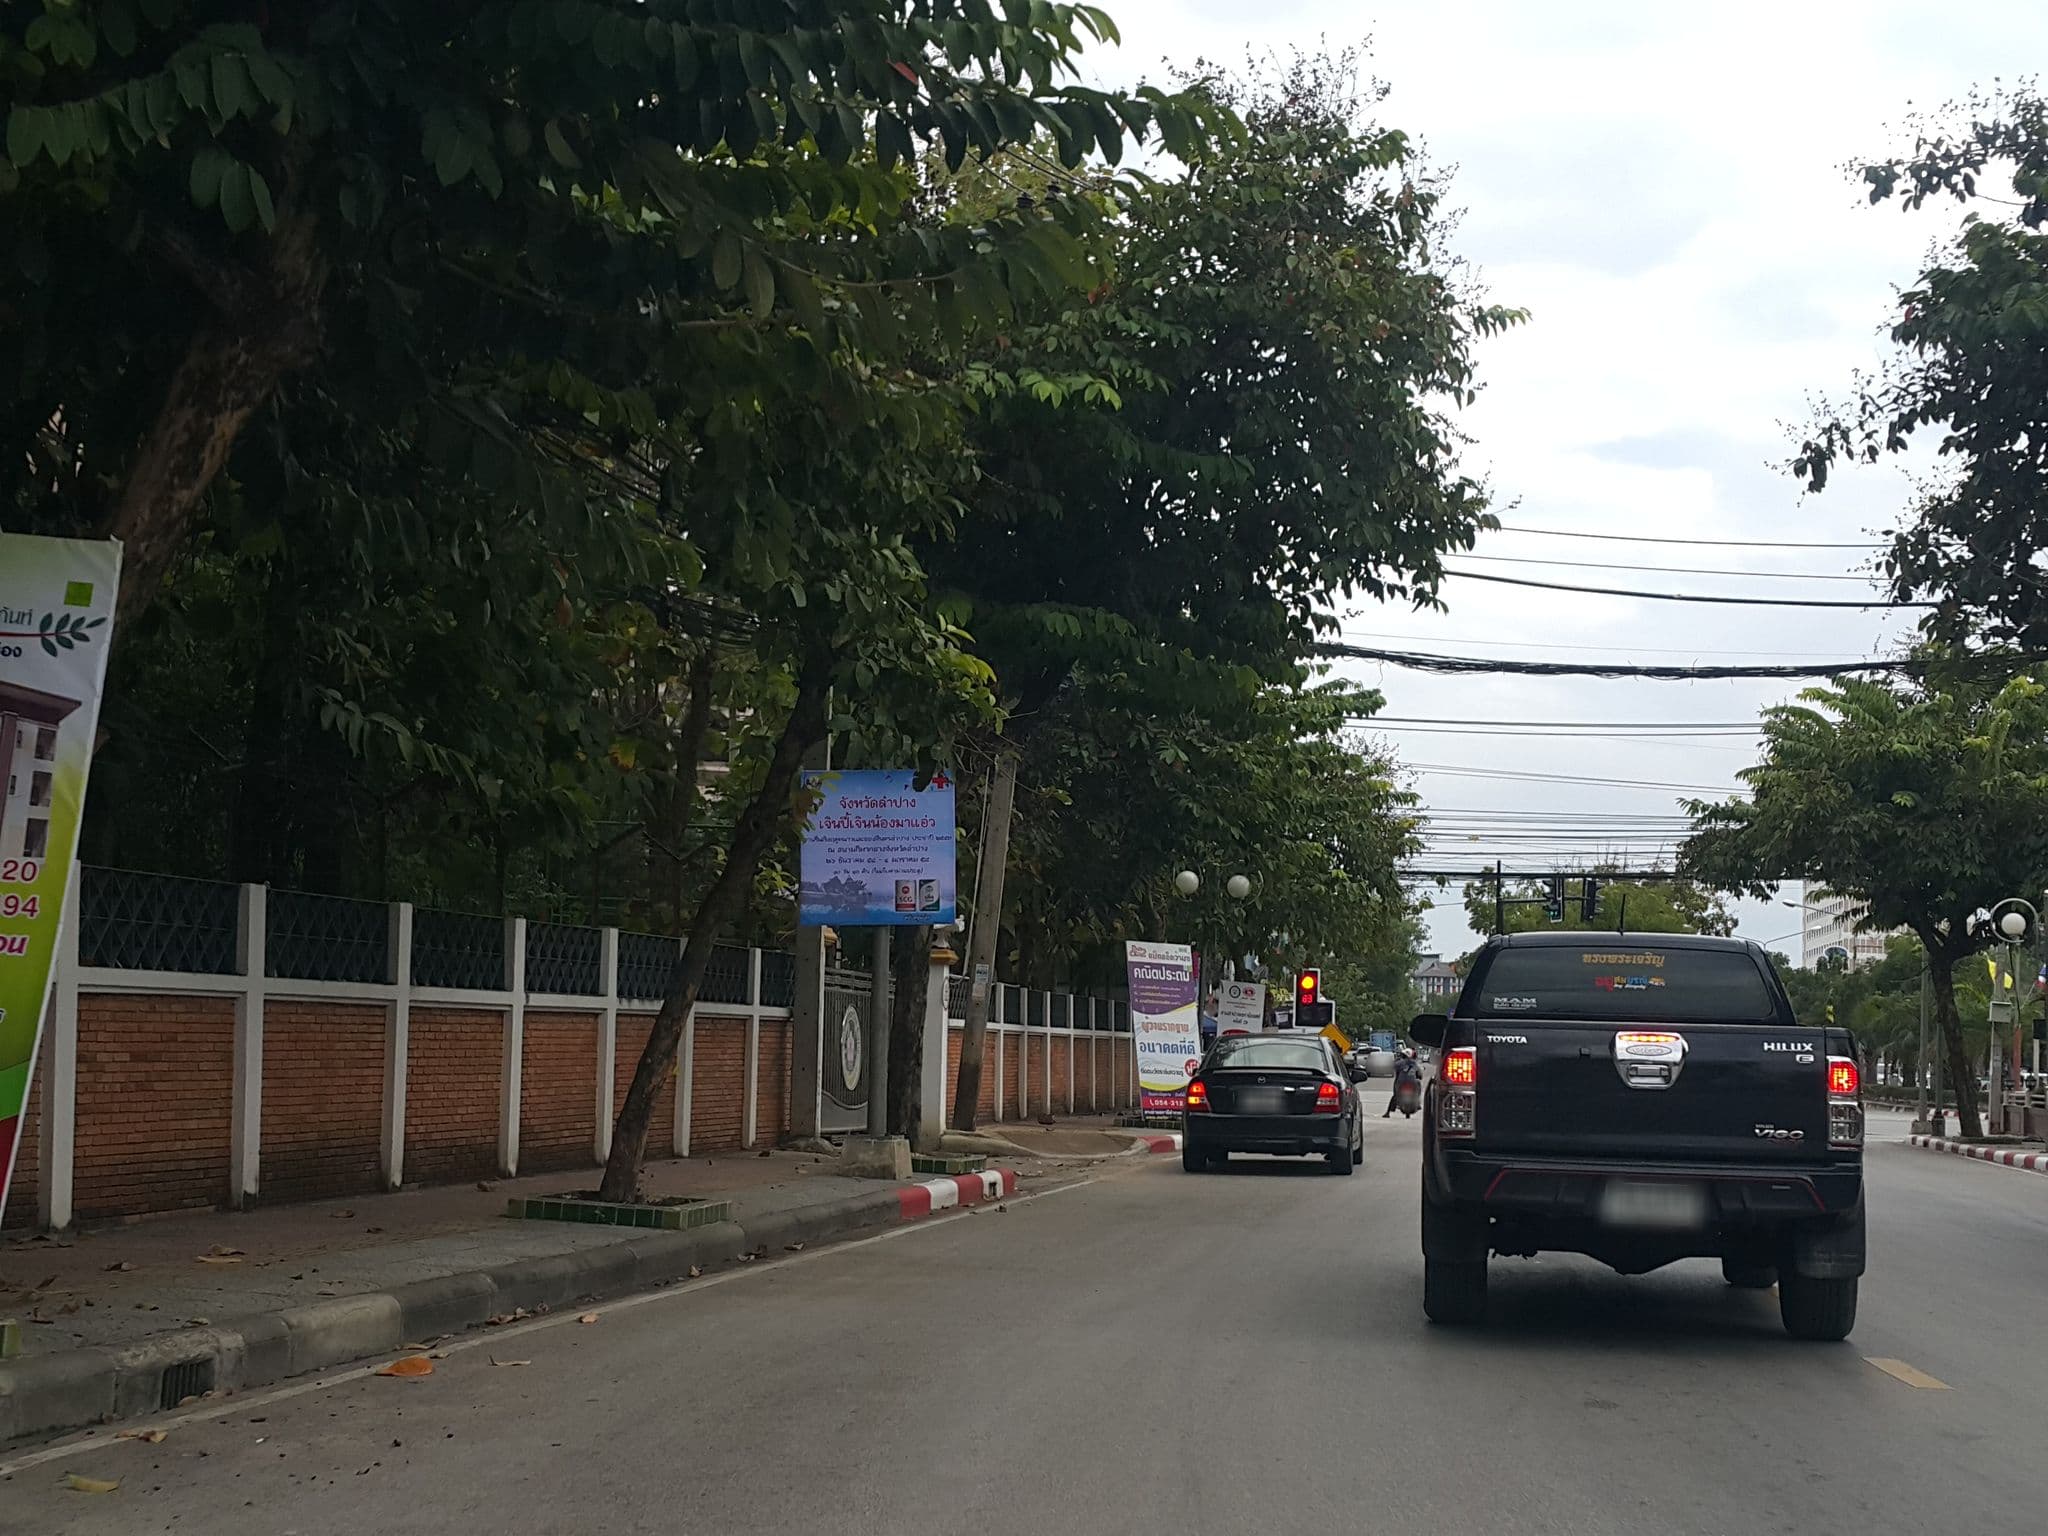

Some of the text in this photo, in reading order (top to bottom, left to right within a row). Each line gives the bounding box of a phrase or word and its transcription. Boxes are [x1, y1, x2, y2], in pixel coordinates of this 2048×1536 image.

[839, 796, 916, 809] จังหวัดลำปาง
[2, 860, 38, 881] 20
[3, 895, 38, 917] 94
[1582, 951, 1665, 968] ทรงพระเจริญ
[1133, 965, 1190, 982] คณิตประถม
[1139, 1038, 1196, 1054] อนาคตที่ดี
[1486, 1035, 1528, 1044] TOYOTA
[1763, 1042, 1814, 1052] HILUX
[1754, 1128, 1805, 1139] VIGO
